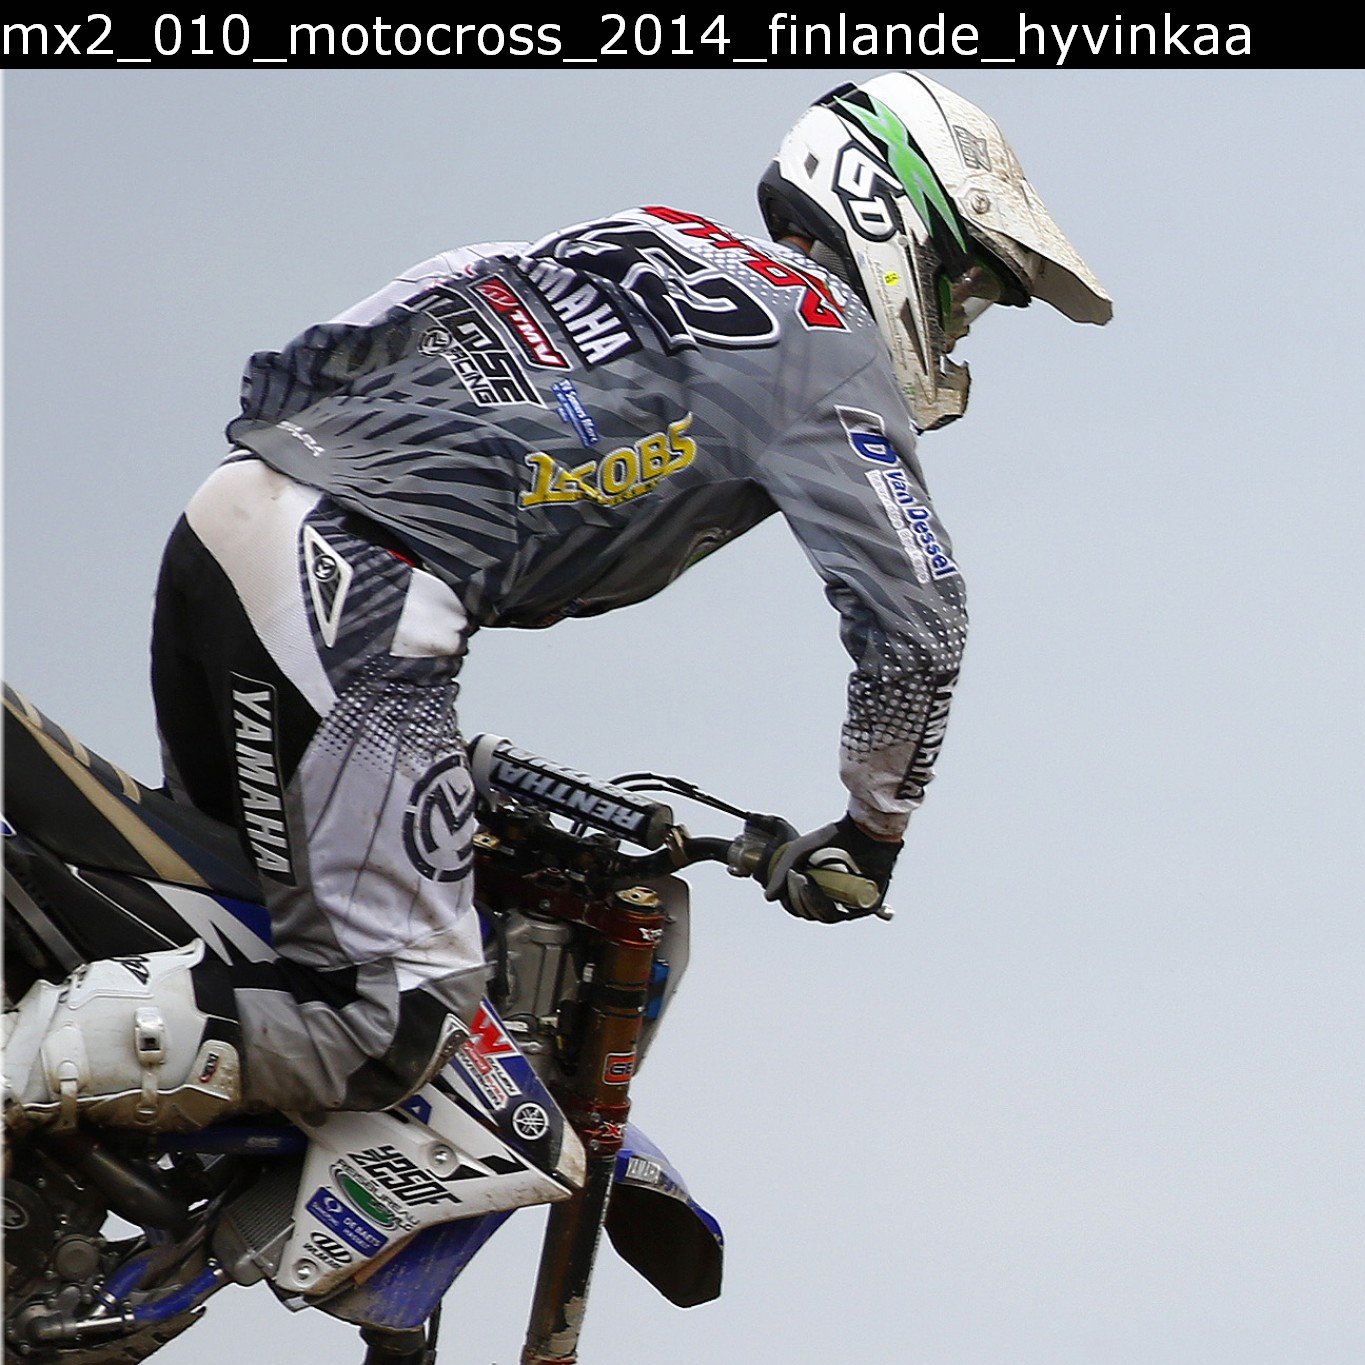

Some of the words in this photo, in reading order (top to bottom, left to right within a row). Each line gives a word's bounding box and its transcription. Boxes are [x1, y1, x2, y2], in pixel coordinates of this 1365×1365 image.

[508, 308, 562, 366] TMV
[885, 470, 915, 505] Van
[907, 506, 957, 577] Dessel
[232, 689, 292, 874] YAMAHA
